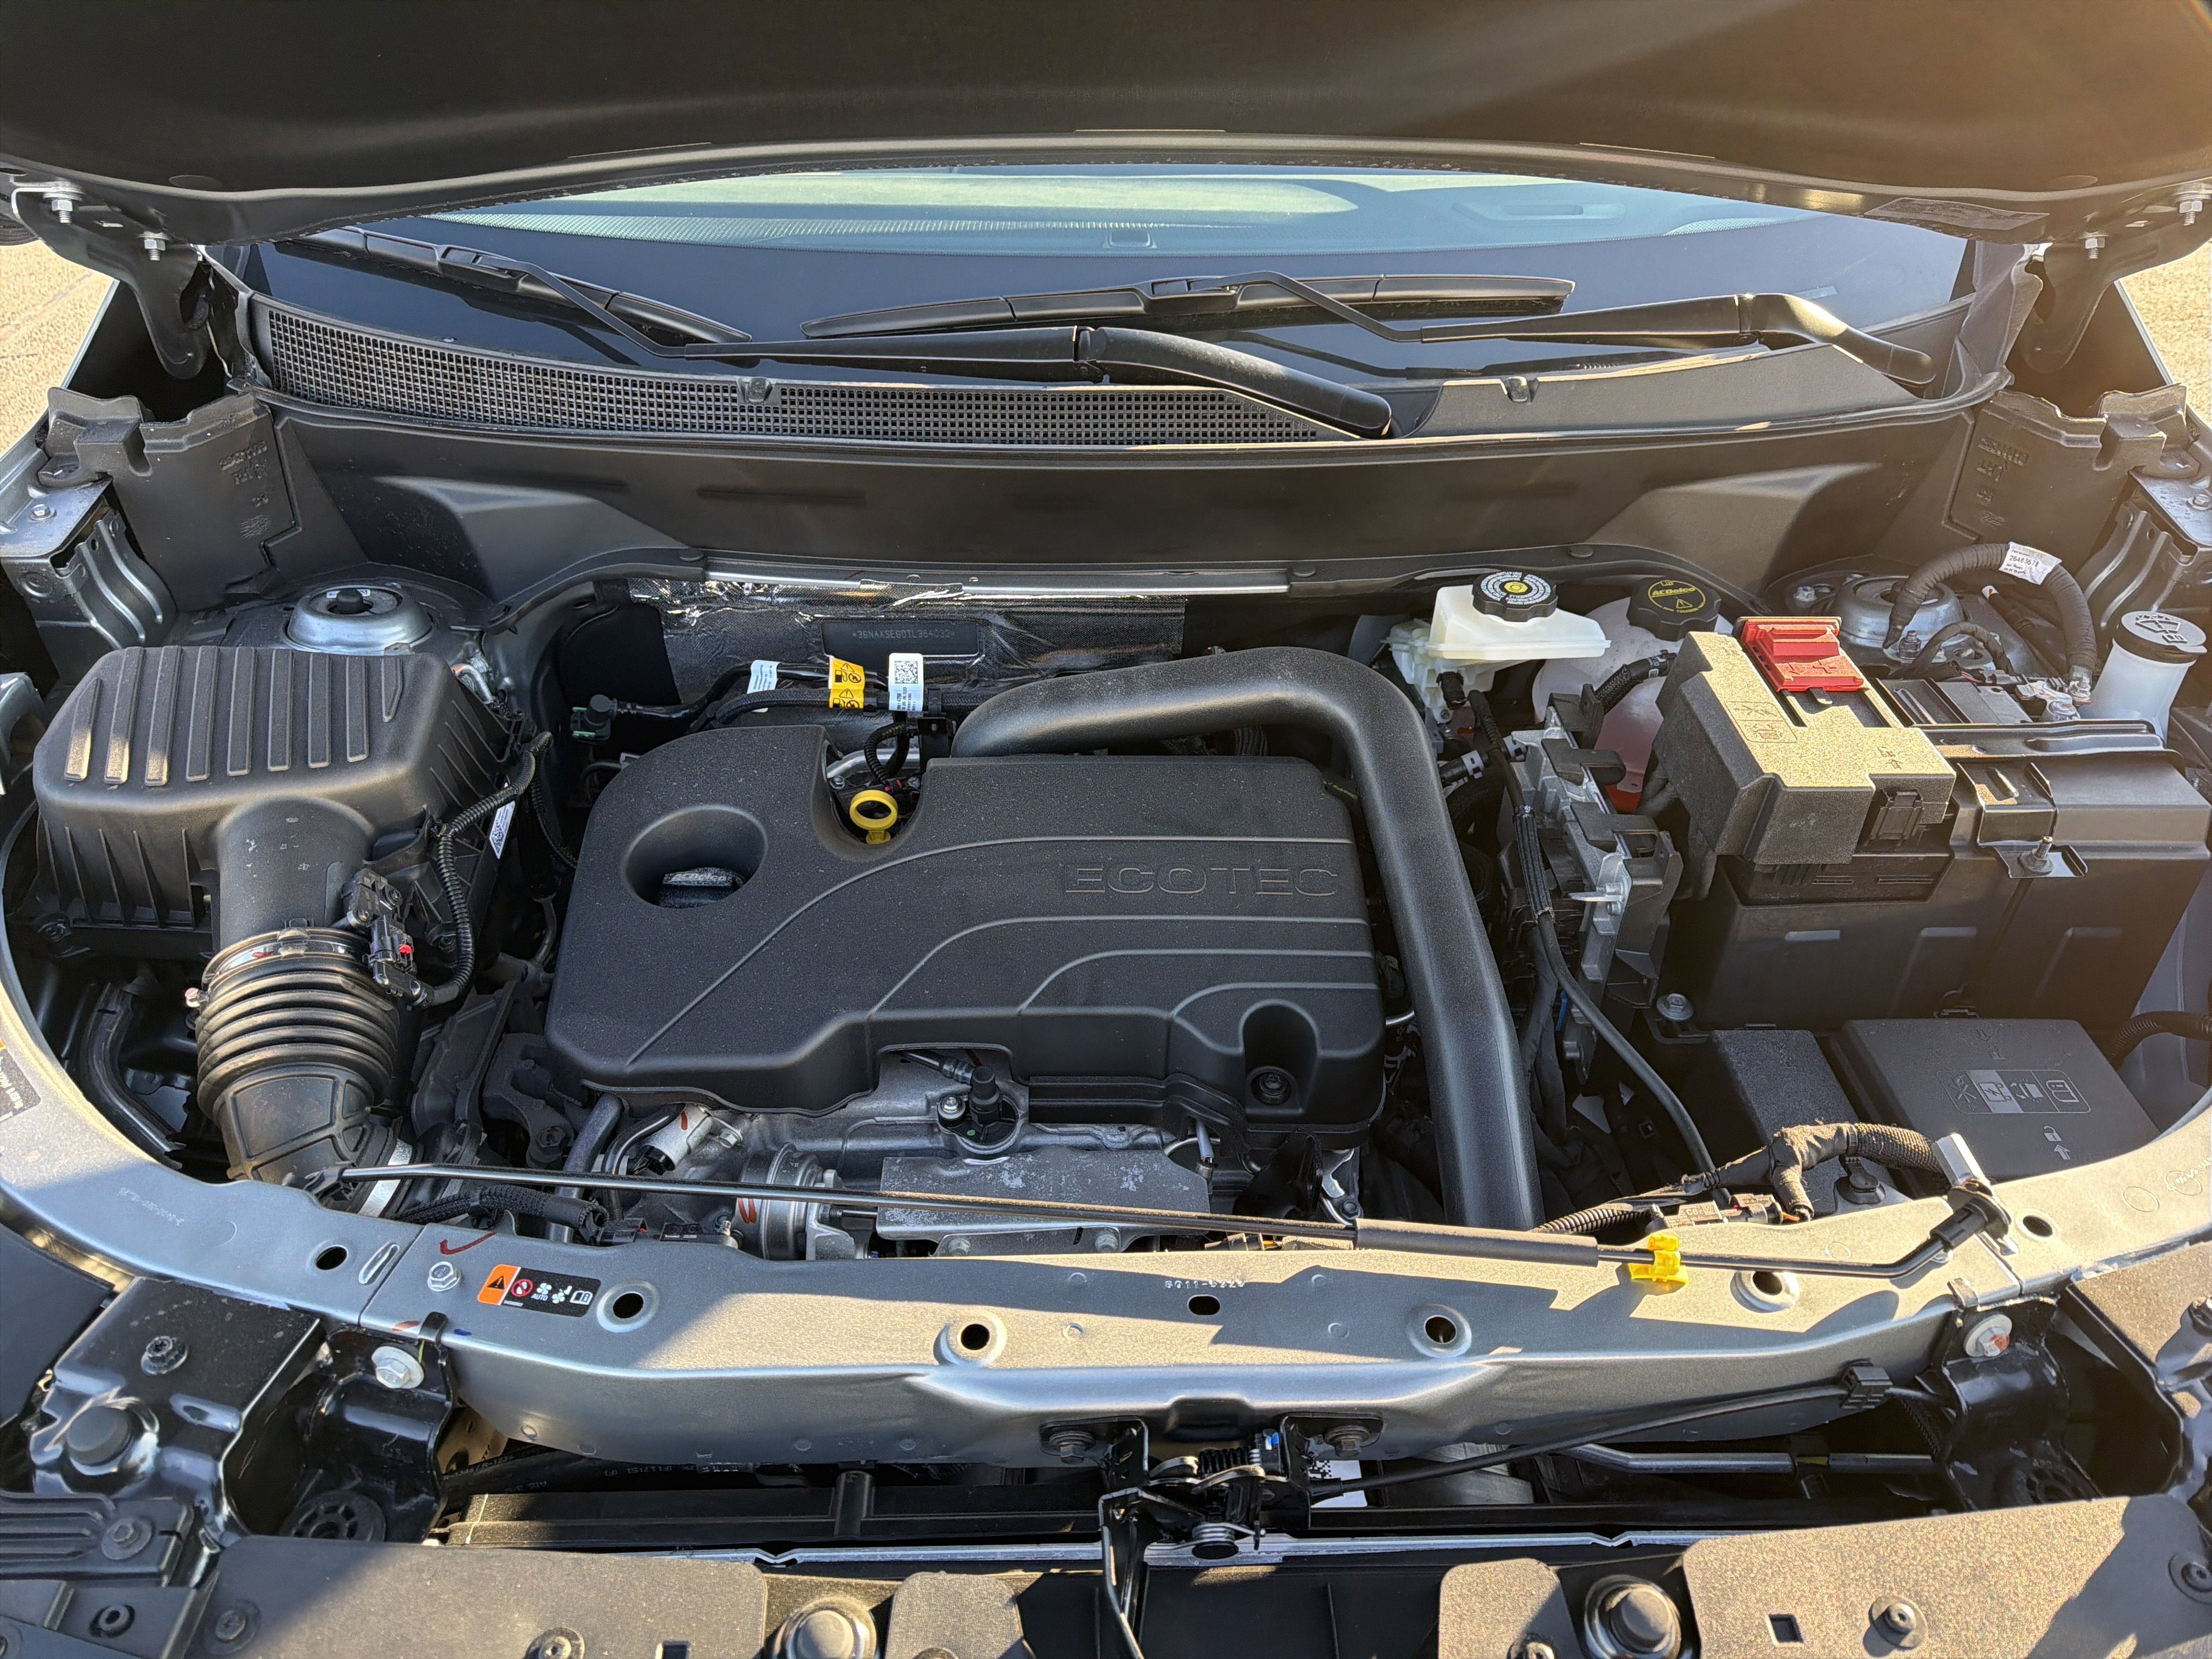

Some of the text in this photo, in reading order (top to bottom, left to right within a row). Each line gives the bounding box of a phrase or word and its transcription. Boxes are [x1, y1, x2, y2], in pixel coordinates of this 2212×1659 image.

[1652, 587, 1696, 596] ACDelco
[1064, 865, 1339, 897] ECOTEC
[531, 1293, 549, 1301] AUTO
